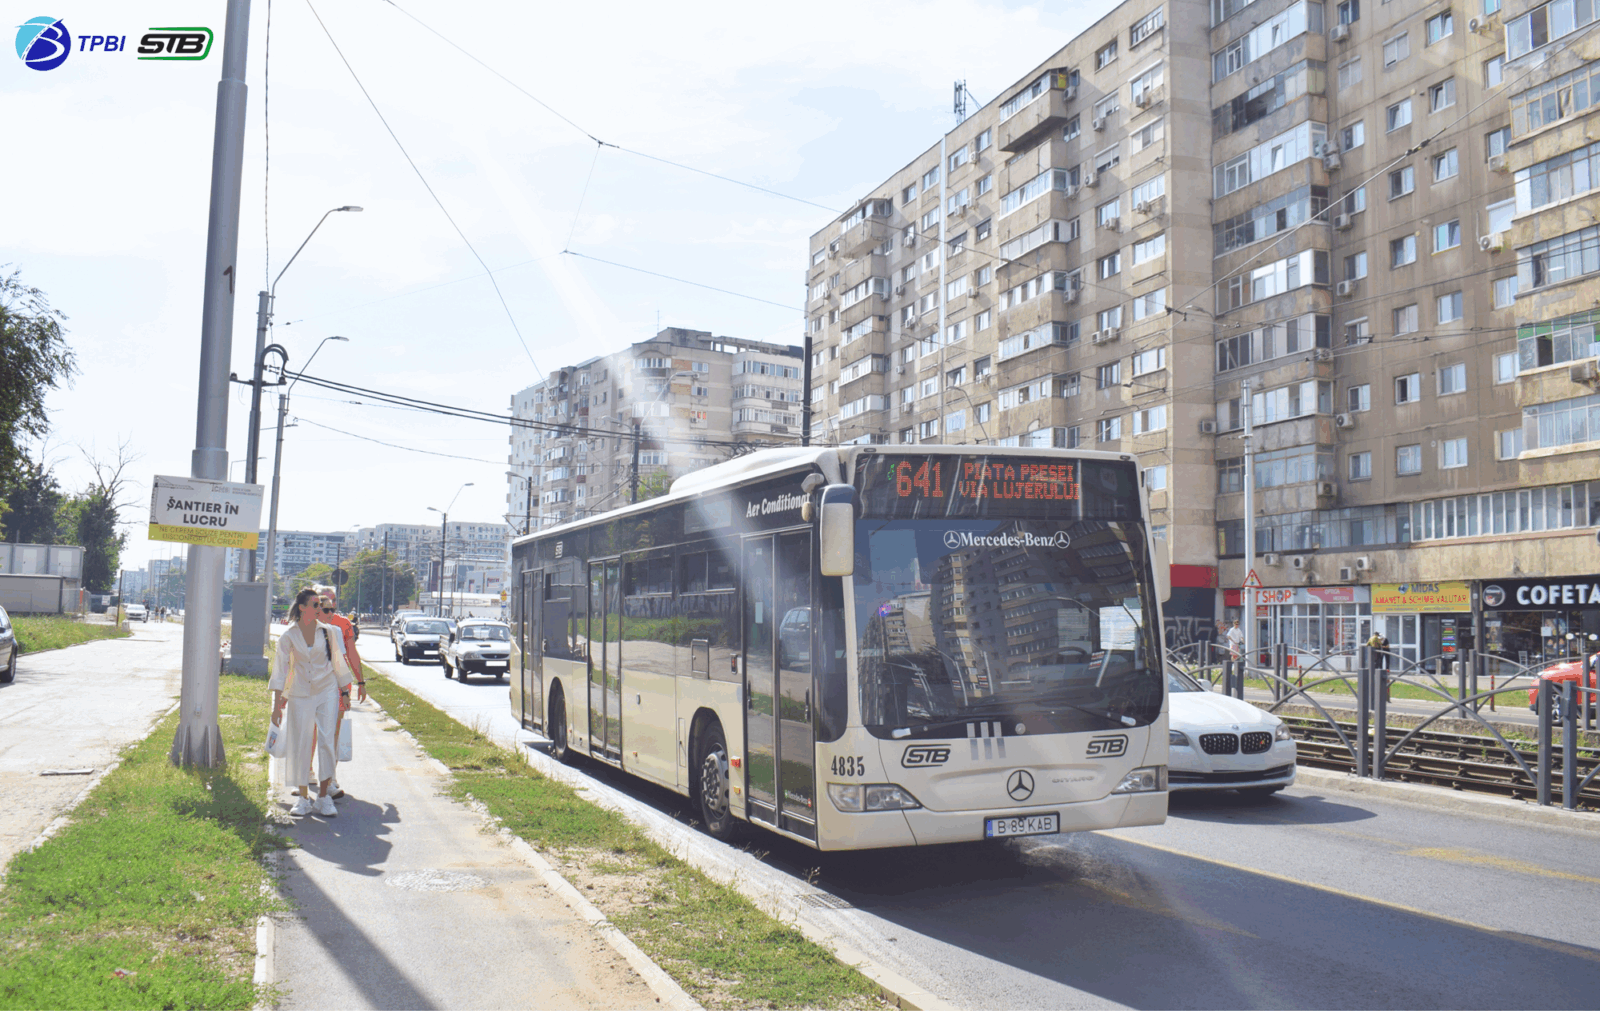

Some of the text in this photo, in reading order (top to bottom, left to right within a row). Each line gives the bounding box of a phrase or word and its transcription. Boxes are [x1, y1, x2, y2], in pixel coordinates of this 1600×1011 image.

[896, 461, 1074, 498] 641 PIATA PRESEI
[959, 481, 1080, 500] VIA LUJERULUI
[224, 501, 239, 515] ÎN
[746, 501, 760, 518] Aer
[182, 513, 228, 527] LUCRU
[960, 531, 1055, 548] Mercedes-Benz
[1262, 589, 1292, 603] SHOP
[1411, 582, 1440, 593] MIDAS
[1086, 738, 1125, 755] STB
[906, 748, 951, 764] STB
[831, 755, 865, 777] 4835
[998, 817, 1052, 834] B 89 KAB
